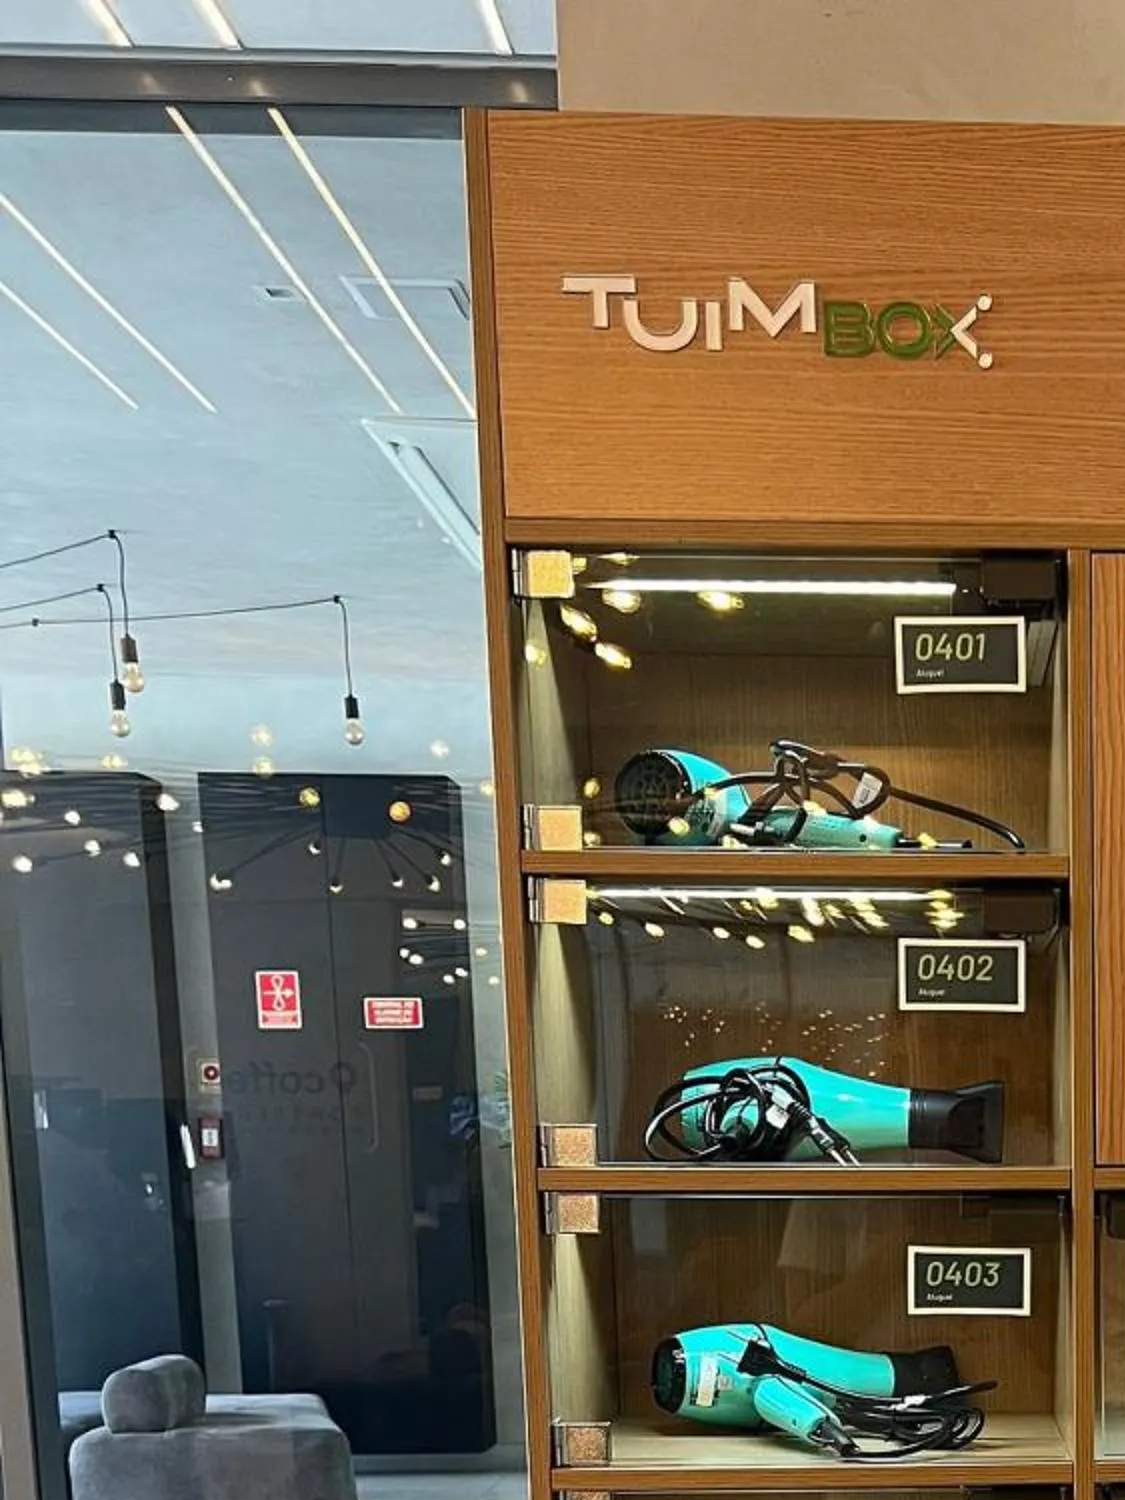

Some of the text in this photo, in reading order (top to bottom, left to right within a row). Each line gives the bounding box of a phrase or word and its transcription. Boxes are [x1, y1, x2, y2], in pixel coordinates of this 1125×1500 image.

[561, 273, 993, 369] TUIMBOX
[915, 632, 985, 662] 0401
[917, 953, 994, 982] 0402
[926, 1260, 1001, 1287] 0403
